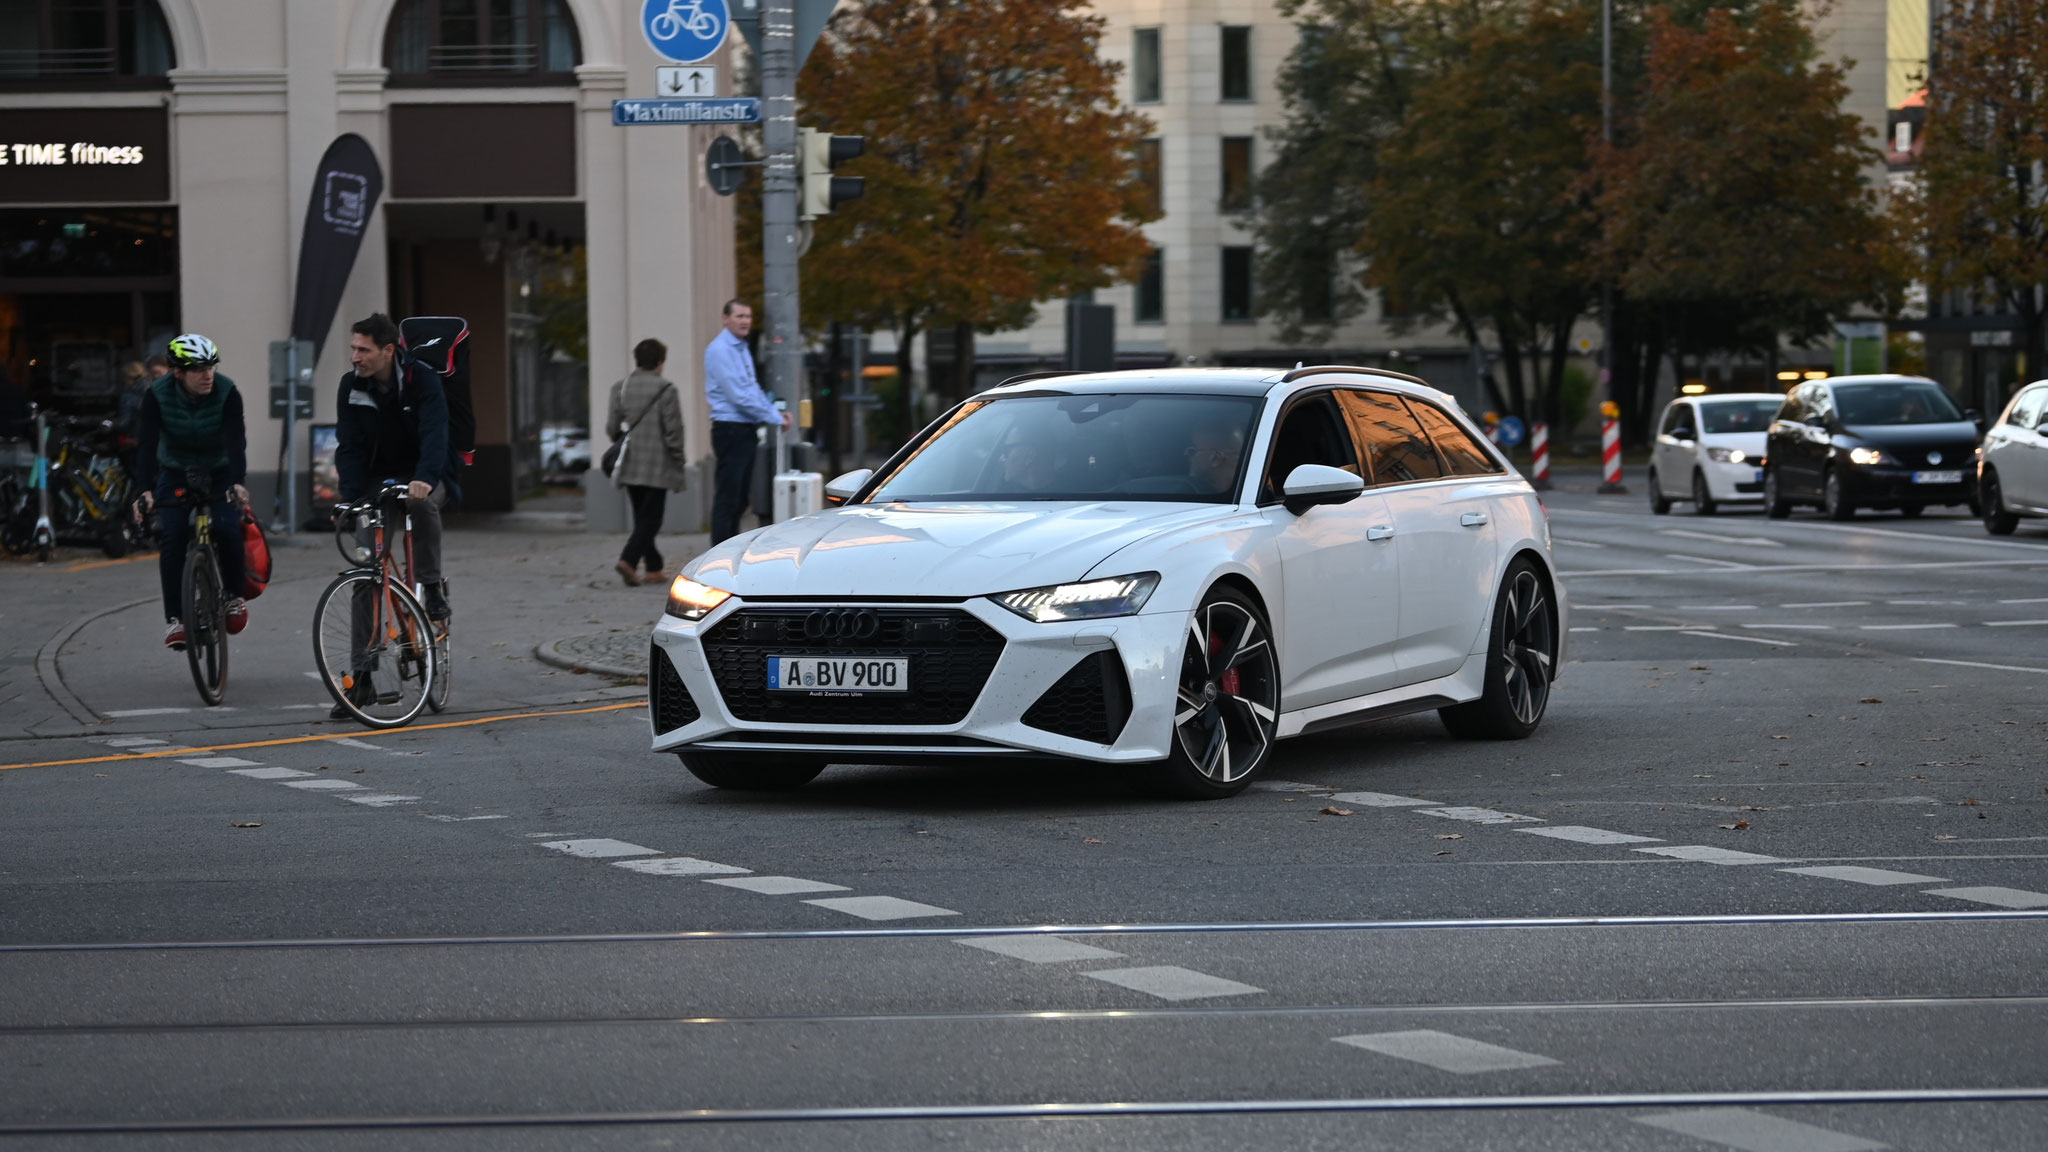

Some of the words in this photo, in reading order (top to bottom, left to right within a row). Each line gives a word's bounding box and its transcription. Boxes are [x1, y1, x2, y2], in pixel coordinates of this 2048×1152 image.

[623, 102, 752, 122] Maximilianstr.
[11, 143, 67, 166] TIME
[70, 142, 144, 165] fitness
[852, 661, 897, 687] 900
